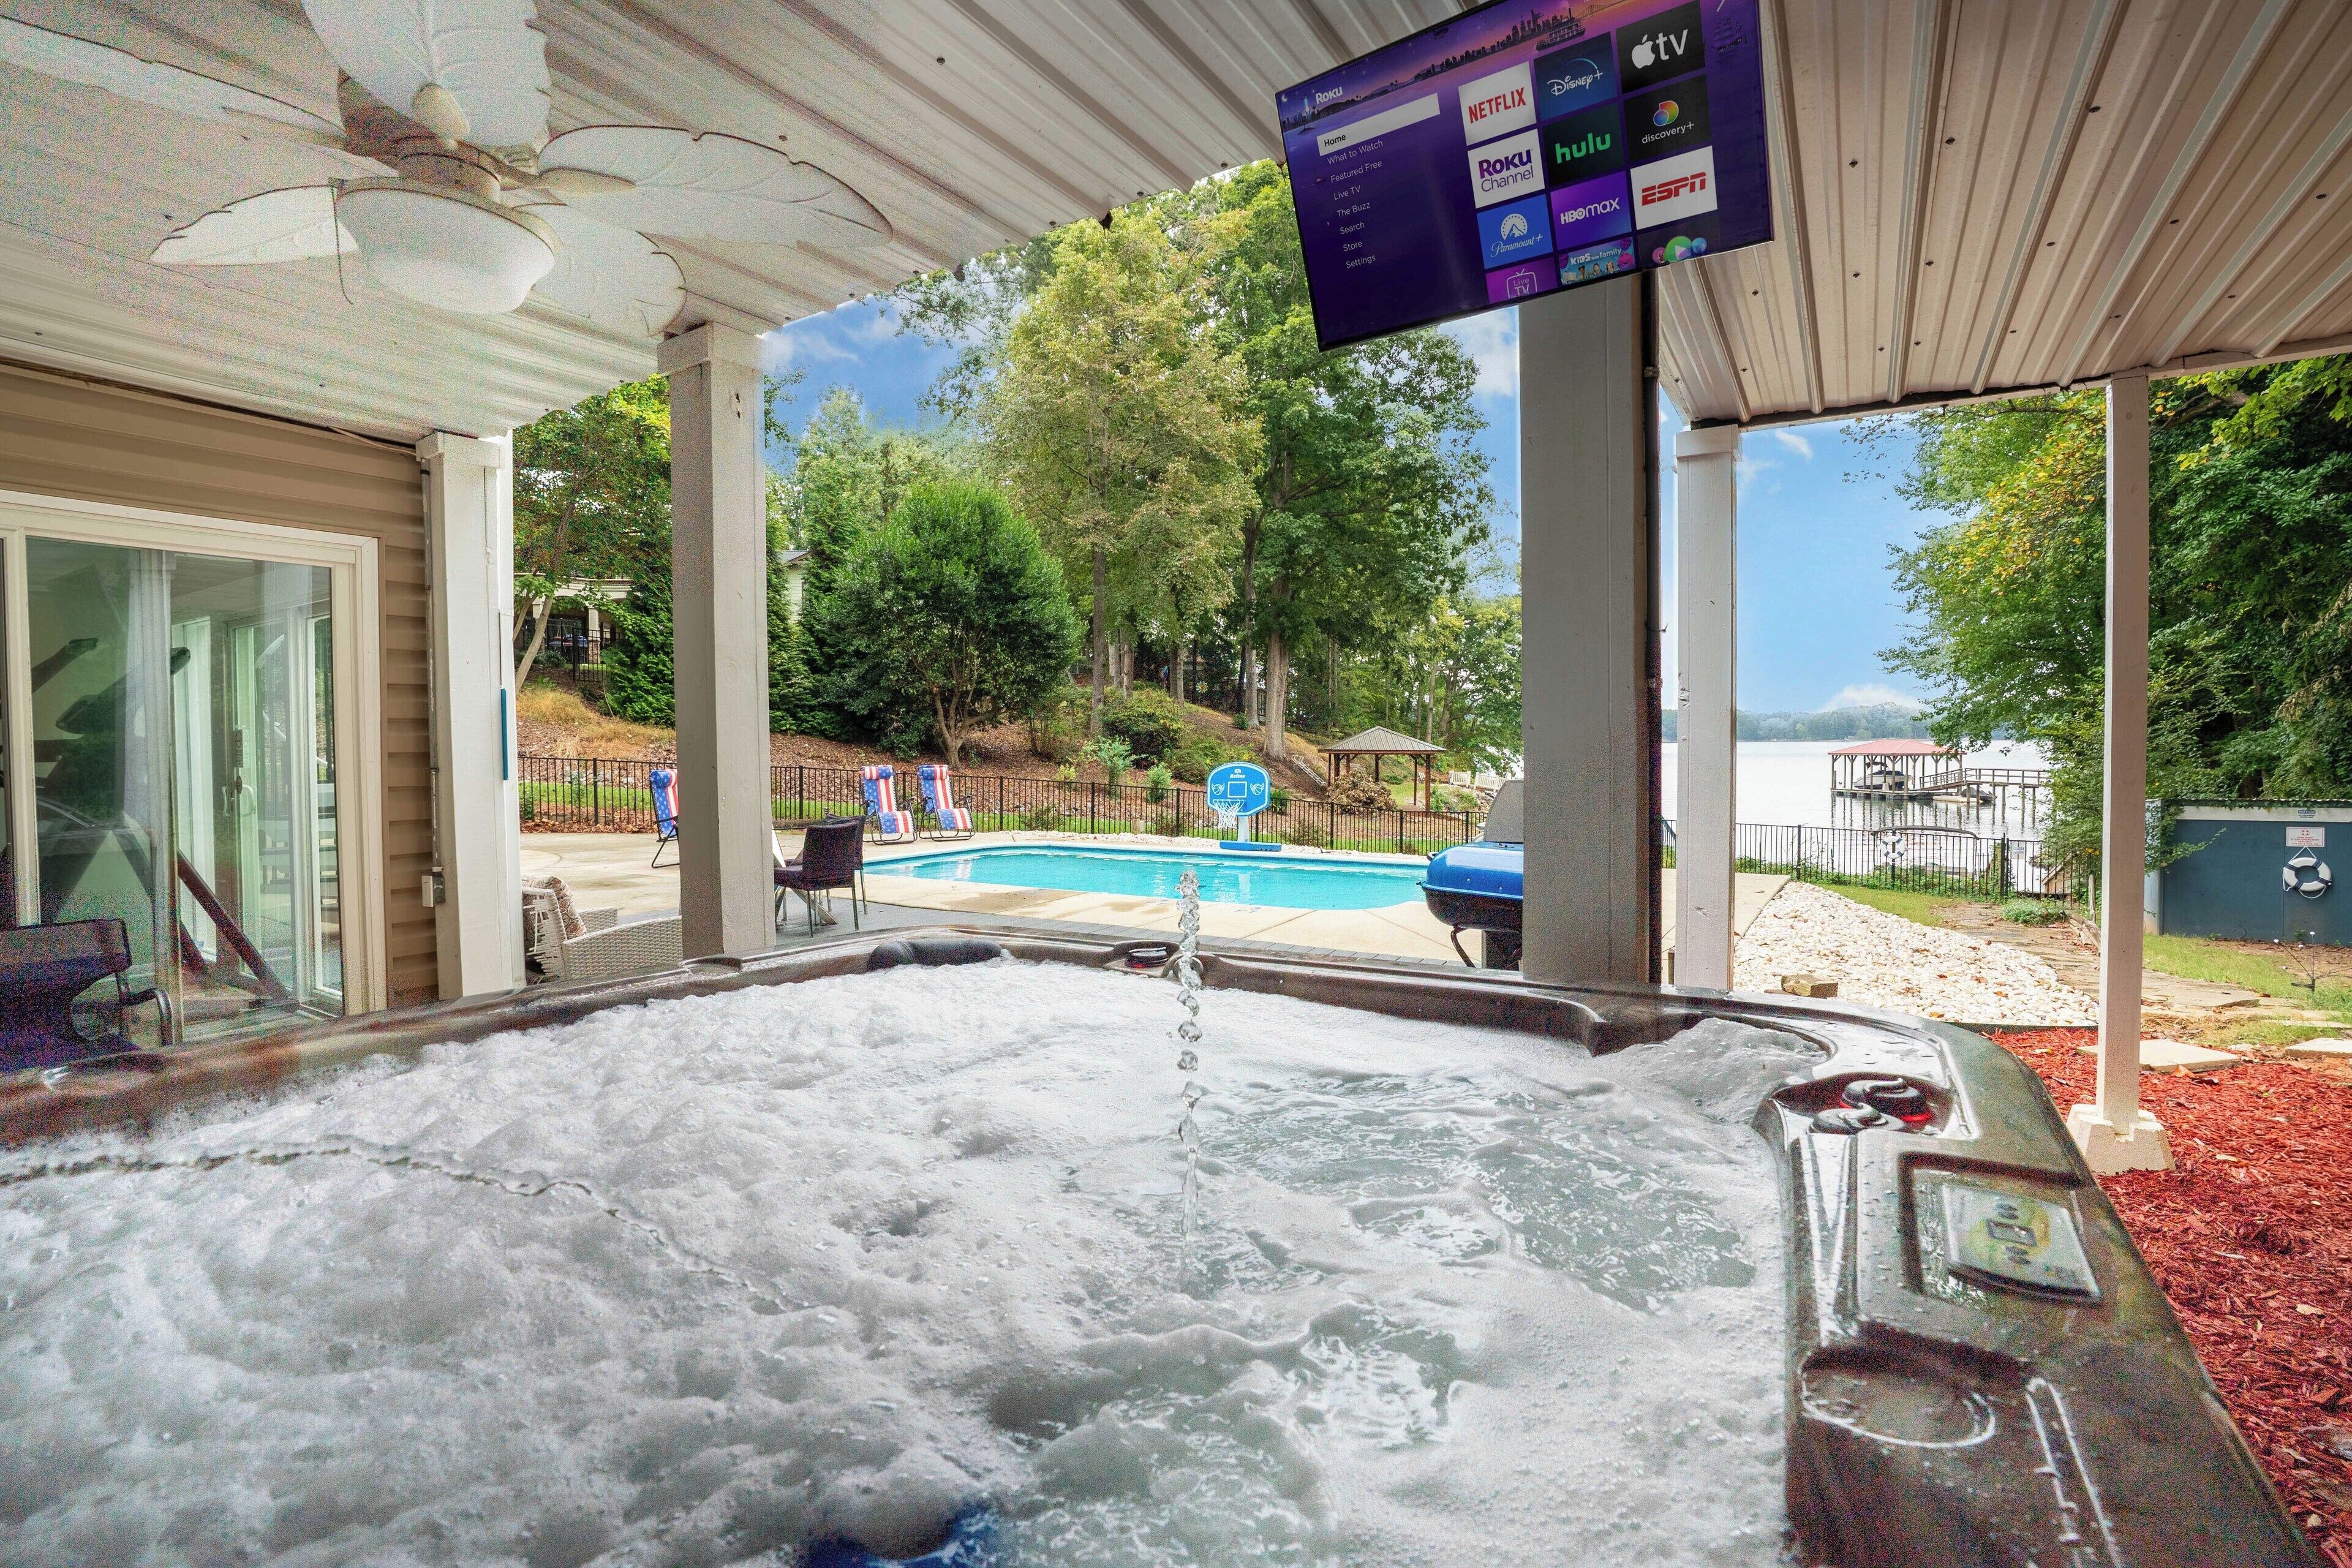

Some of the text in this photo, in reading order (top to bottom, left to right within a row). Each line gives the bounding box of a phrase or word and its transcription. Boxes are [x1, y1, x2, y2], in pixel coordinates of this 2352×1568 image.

[1656, 29, 1689, 61] tv
[1547, 69, 1604, 96] Disney+
[1315, 86, 1343, 105] Roku
[1468, 87, 1527, 124] NETFLIX
[1324, 134, 1346, 147] Home
[1642, 121, 1694, 144] discovery+
[1327, 140, 1384, 165] What to Watch
[1555, 132, 1611, 164] hulu
[1330, 160, 1382, 183] Featured Free
[1478, 149, 1532, 179] Roku
[1481, 165, 1534, 192] Channel
[1642, 172, 1706, 206] ESPN
[1333, 185, 1361, 200] Live TV
[1336, 202, 1371, 217] The Buzz
[1340, 221, 1365, 235] Search
[1343, 241, 1363, 252] Store
[1490, 233, 1544, 258] Paramount+
[1599, 248, 1622, 258] family
[1346, 255, 1376, 268] Settings
[1513, 278, 1529, 287] Live
